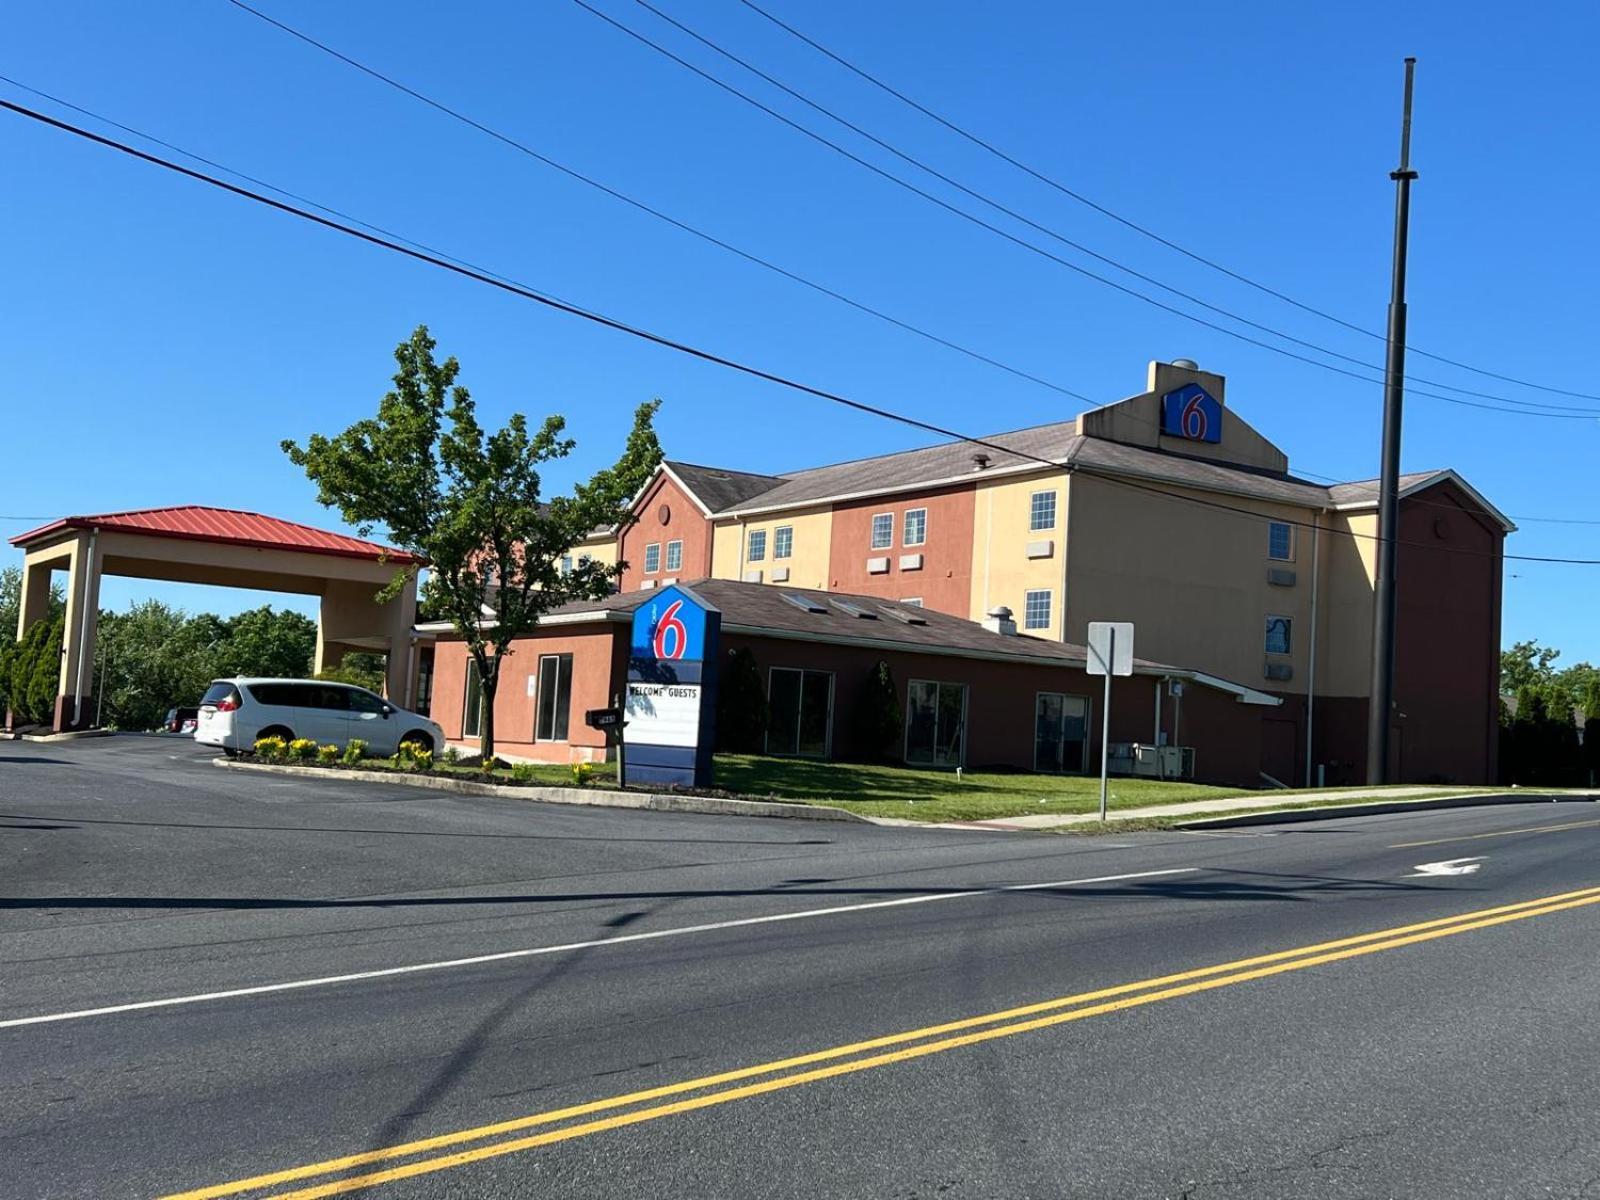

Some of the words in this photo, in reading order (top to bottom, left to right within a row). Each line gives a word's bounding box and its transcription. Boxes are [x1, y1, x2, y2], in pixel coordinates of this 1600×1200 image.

[1182, 393, 1207, 441] 6
[653, 599, 687, 660] 6
[629, 686, 663, 697] WELCOME
[668, 688, 697, 698] GUESTS
